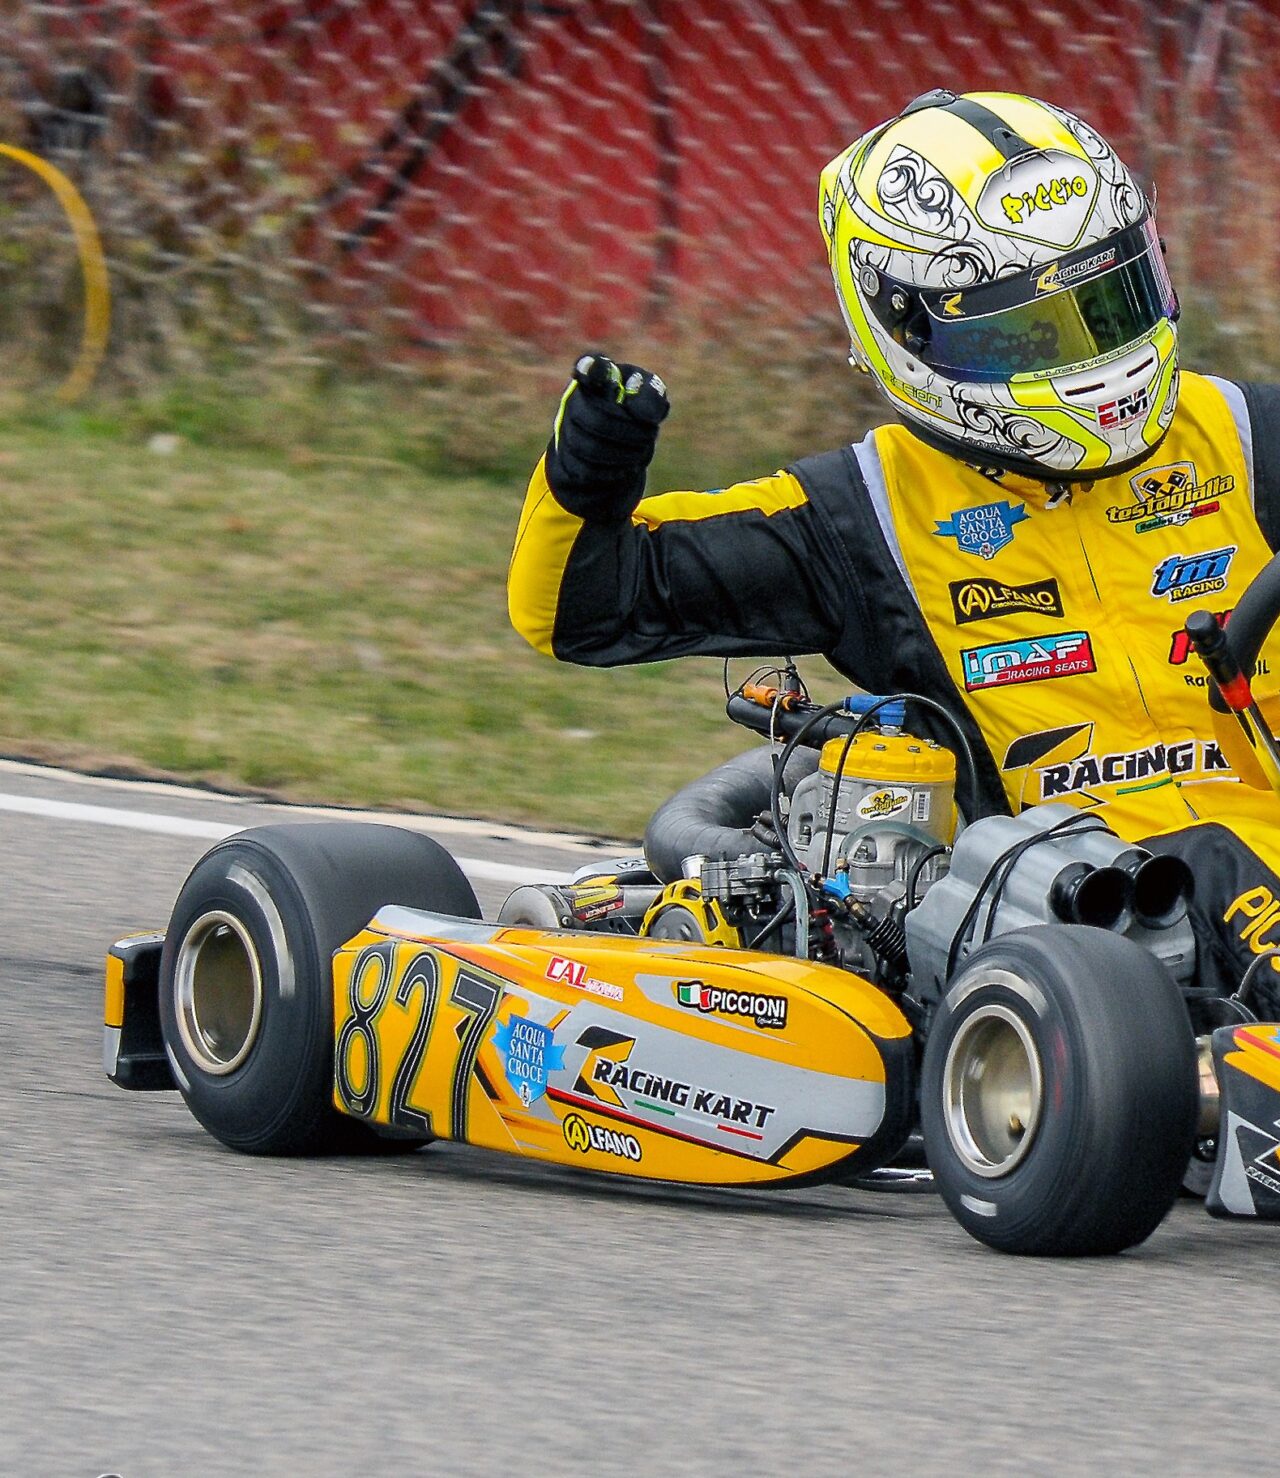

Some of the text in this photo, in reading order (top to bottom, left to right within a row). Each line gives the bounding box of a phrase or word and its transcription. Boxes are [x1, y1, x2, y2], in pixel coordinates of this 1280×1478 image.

[1106, 475, 1235, 523] testagialla
[959, 506, 1001, 525] ACQUA
[959, 517, 1006, 536] SANTA
[961, 527, 1008, 546] CROCE
[958, 583, 1055, 617] ALFANO
[1171, 578, 1225, 602] RACING
[1010, 659, 1089, 680] RACING SEATS
[1041, 742, 1194, 798] RACING
[546, 957, 588, 988] CAL
[711, 989, 786, 1018] PICCIONI
[336, 940, 501, 1142] 827
[511, 1022, 546, 1047] ACQUA
[509, 1039, 544, 1066] SANTA
[508, 1058, 544, 1084] CROCE
[592, 1058, 776, 1129] RACING KART
[563, 1113, 642, 1161] ALFANO
